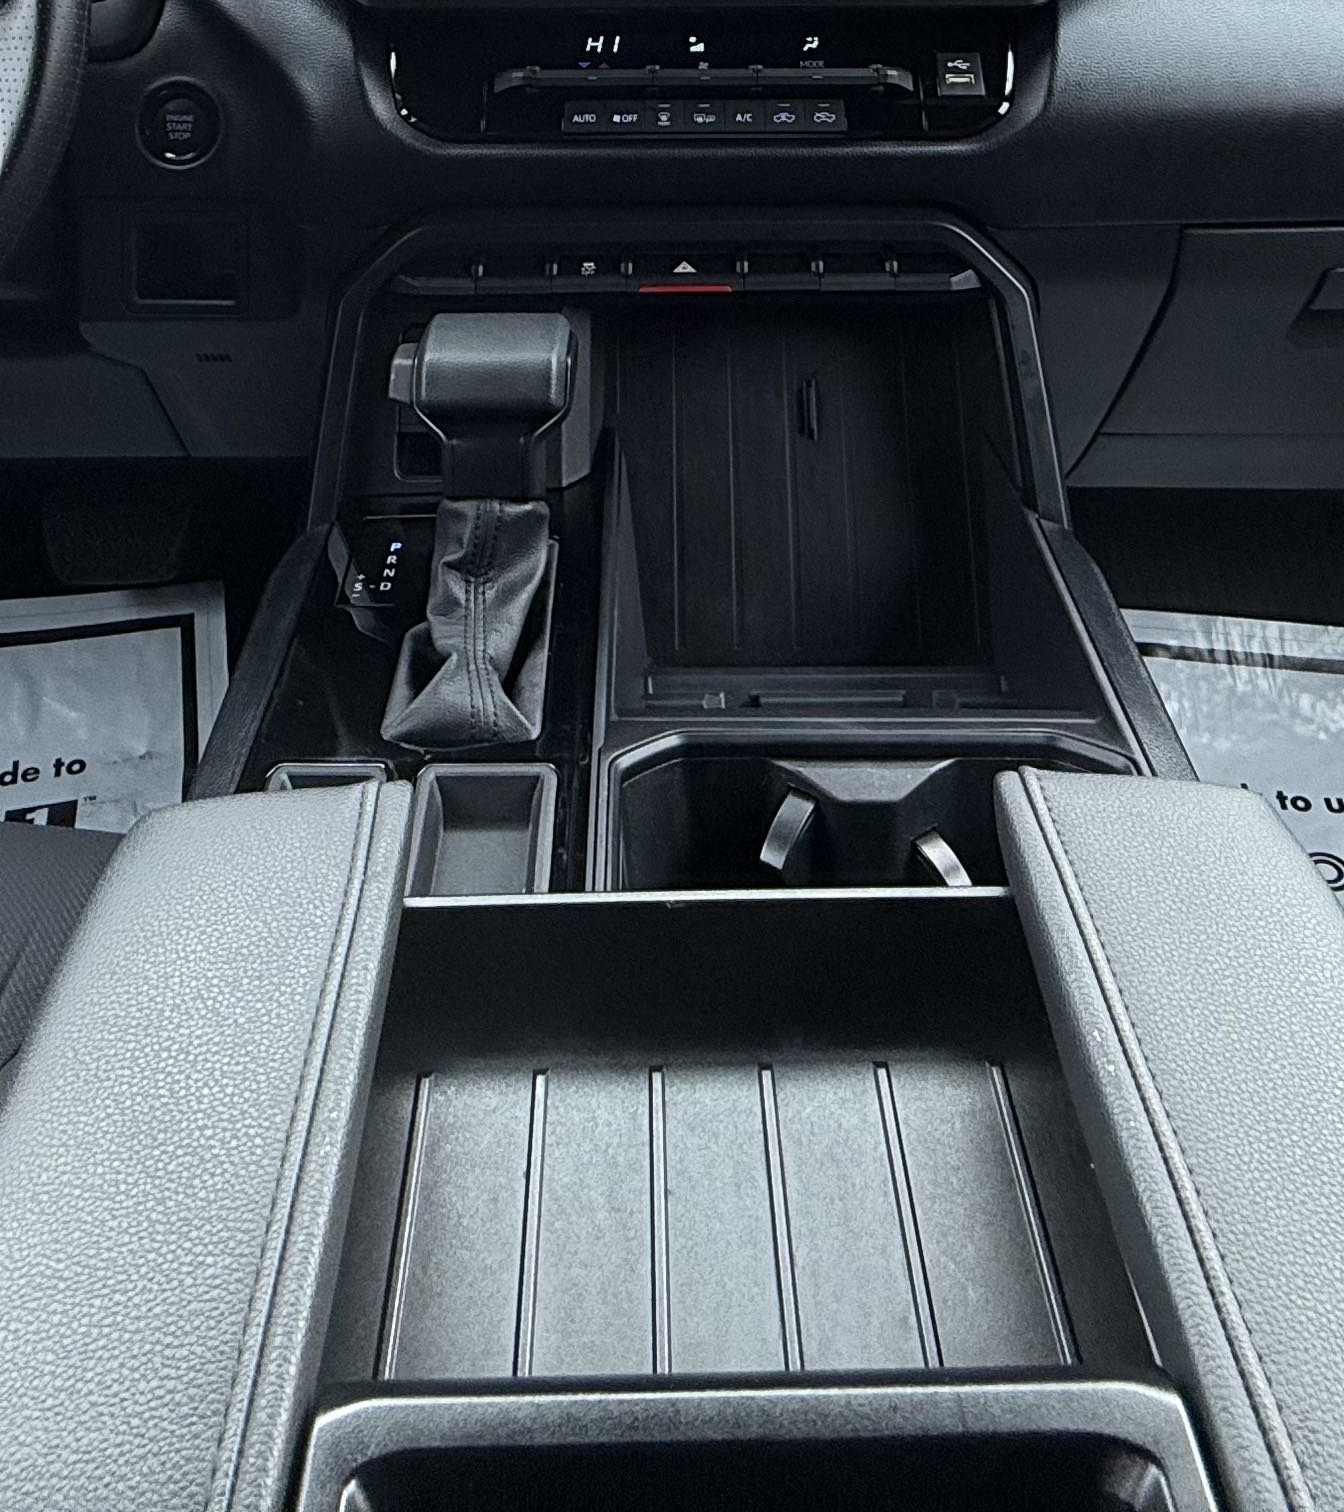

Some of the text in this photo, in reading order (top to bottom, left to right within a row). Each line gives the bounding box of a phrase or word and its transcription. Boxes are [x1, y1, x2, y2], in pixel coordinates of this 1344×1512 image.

[573, 114, 597, 123] AUTO
[621, 114, 638, 123] OFF
[735, 113, 752, 122] A/C
[166, 122, 192, 131] START
[168, 132, 191, 140] STOP
[390, 542, 403, 552] P
[386, 555, 397, 565] R
[383, 568, 396, 578] N
[353, 582, 363, 592] S
[379, 582, 392, 591] D
[52, 757, 87, 778] to
[1276, 790, 1313, 813] to
